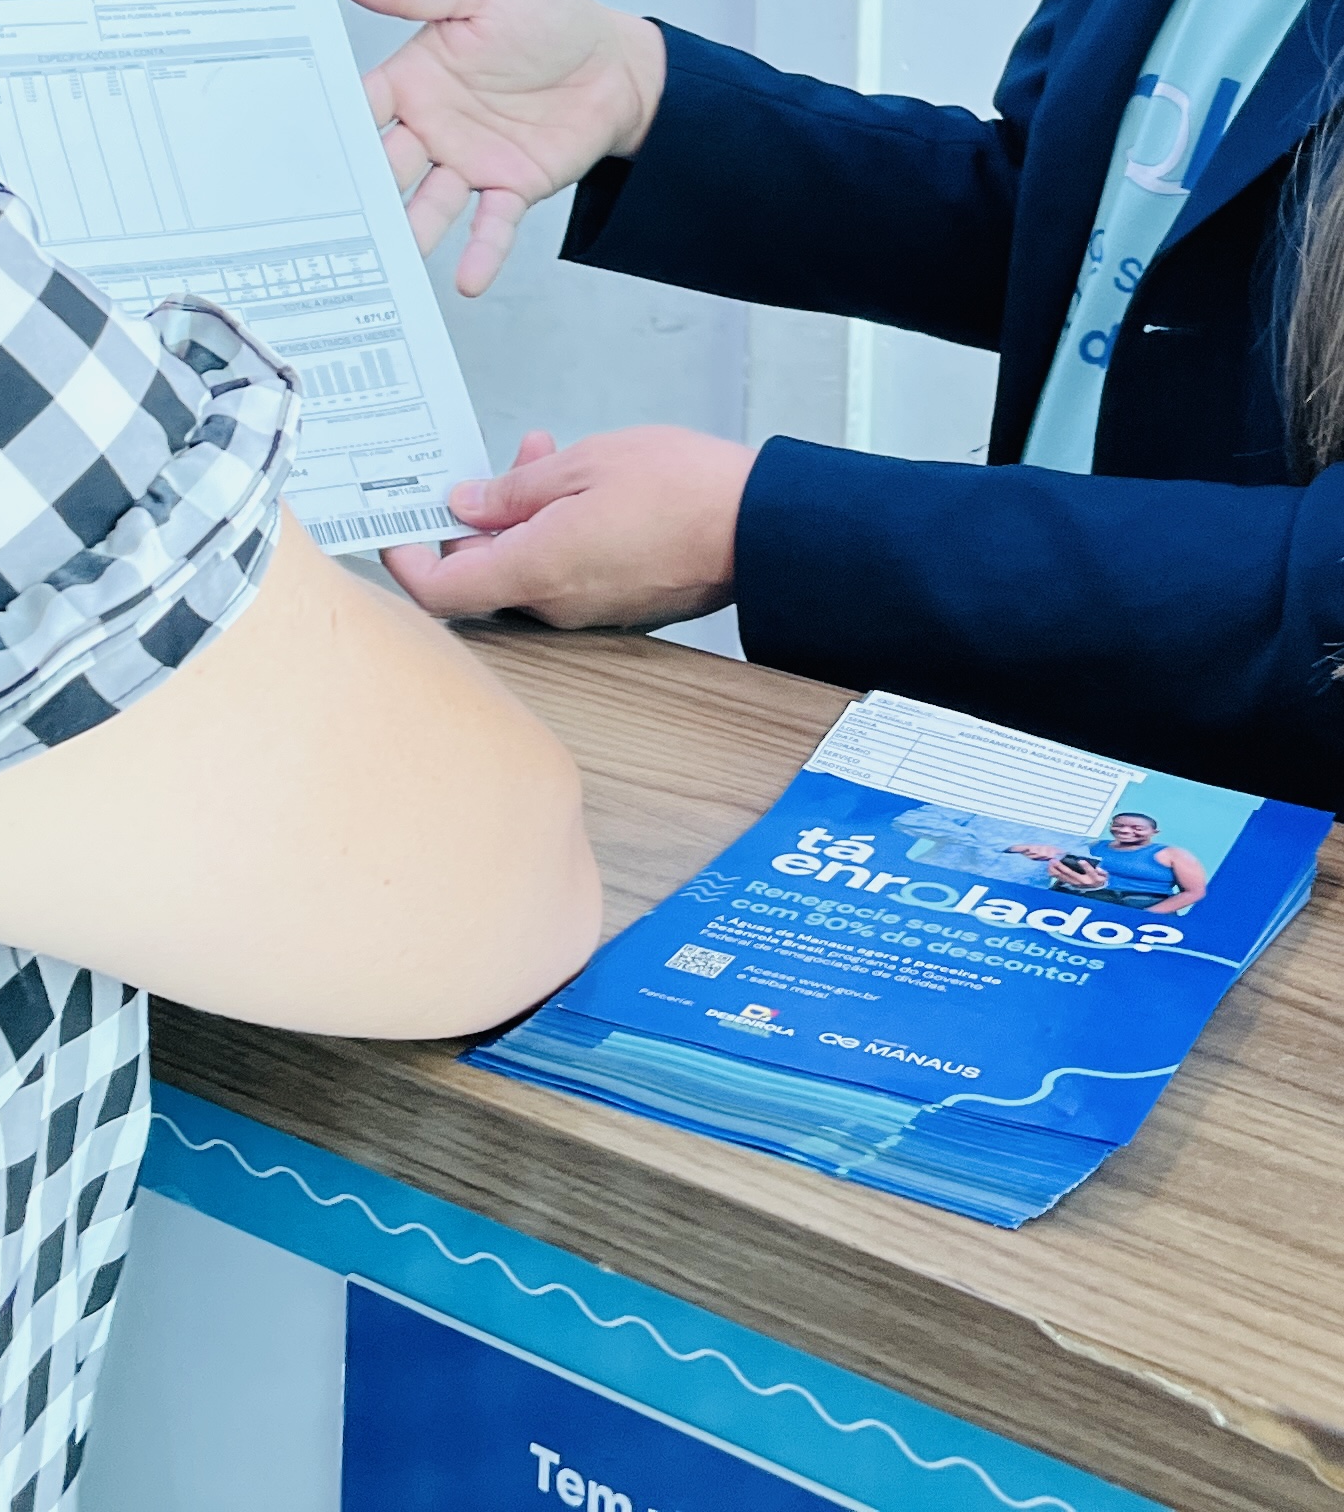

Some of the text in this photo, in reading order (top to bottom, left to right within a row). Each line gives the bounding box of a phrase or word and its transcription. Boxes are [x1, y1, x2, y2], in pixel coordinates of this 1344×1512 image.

[38, 48, 166, 64] ESPECIFICAÇÕES DA CONTA
[282, 302, 312, 312] TOTAL
[322, 294, 354, 306] PAGAR
[364, 329, 396, 340] MESES
[840, 725, 868, 736] LOCAL
[848, 716, 877, 728] SENHA
[874, 713, 913, 726] MANAUS
[834, 733, 859, 743] DATA
[816, 759, 871, 779] PROTOCOLO
[823, 749, 861, 765] SERVIÇO
[958, 731, 1029, 754] AGENDAMENTO
[1063, 759, 1076, 768] DE
[1077, 763, 1119, 779] MANAUS
[797, 825, 875, 863] tá
[771, 851, 1184, 953] enrolado?
[744, 880, 1106, 971] Renegocie seus débitos
[698, 928, 754, 947] Federal
[752, 942, 773, 951] de
[773, 948, 869, 974] renegociação
[871, 969, 892, 979] de
[706, 921, 780, 944] Desenrola
[826, 951, 897, 971] programa
[898, 966, 920, 976] do
[922, 970, 984, 990] Governo
[727, 916, 773, 934] Águas
[775, 930, 795, 939] de
[796, 933, 855, 952] Manaus
[856, 947, 899, 962] agora
[913, 960, 979, 980] parceira
[981, 976, 1002, 986] do
[730, 898, 1091, 986] com 90% de desconto!
[743, 965, 883, 1001] Acesse www.gov.br
[749, 976, 787, 990] saiba
[704, 1008, 795, 1037] DESENROLA
[864, 1043, 981, 1079] MANAUS
[529, 1441, 633, 1512] Tem
